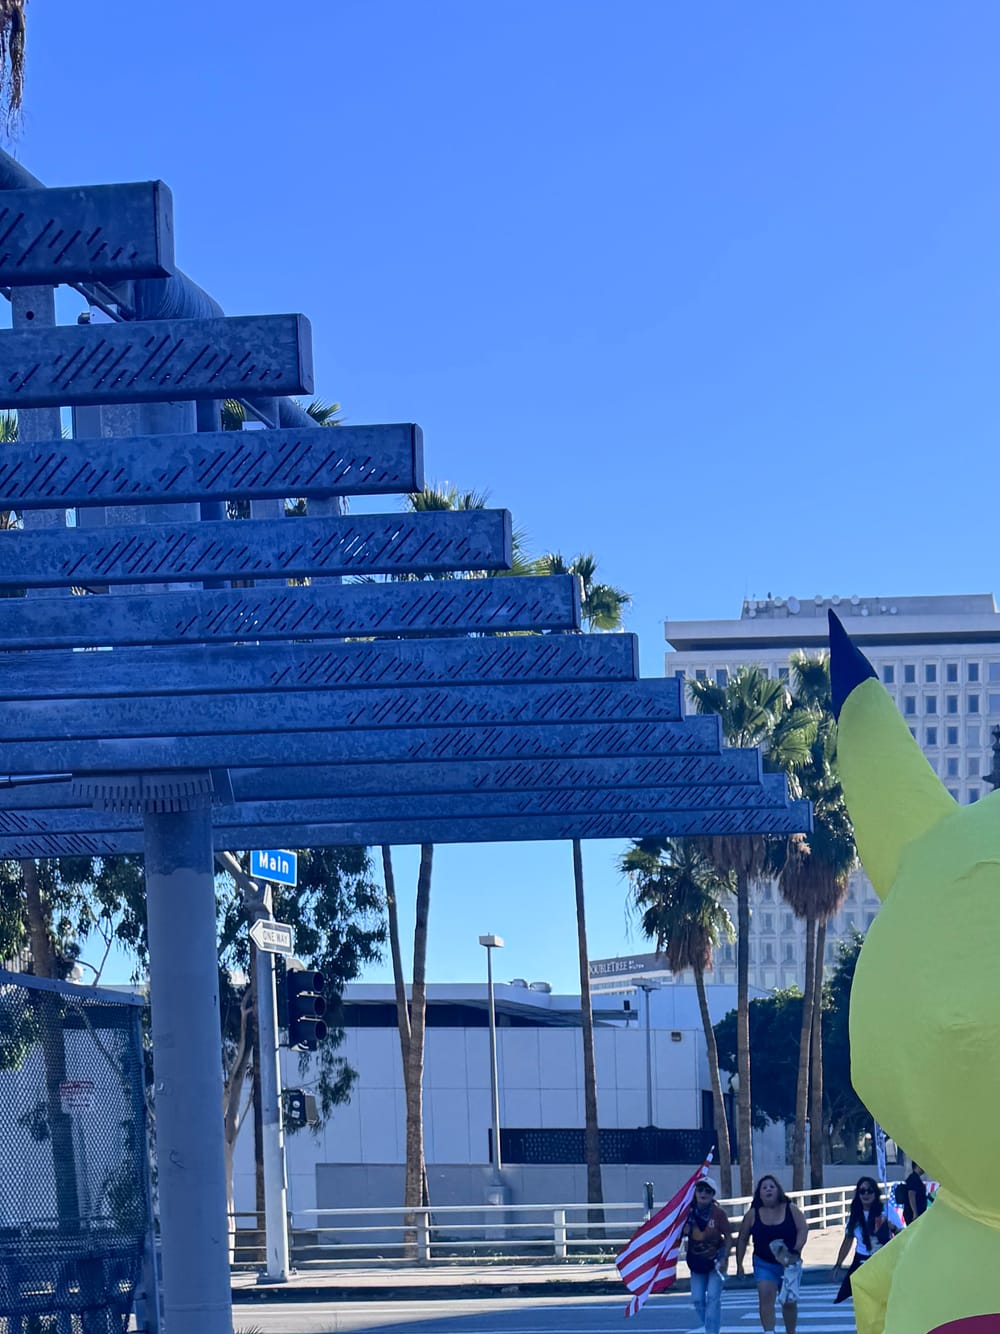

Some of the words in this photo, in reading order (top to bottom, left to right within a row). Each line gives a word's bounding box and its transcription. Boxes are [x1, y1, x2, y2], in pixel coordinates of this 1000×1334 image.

[259, 851, 289, 874] Main
[263, 930, 275, 942] ONE
[275, 931, 288, 944] WAY
